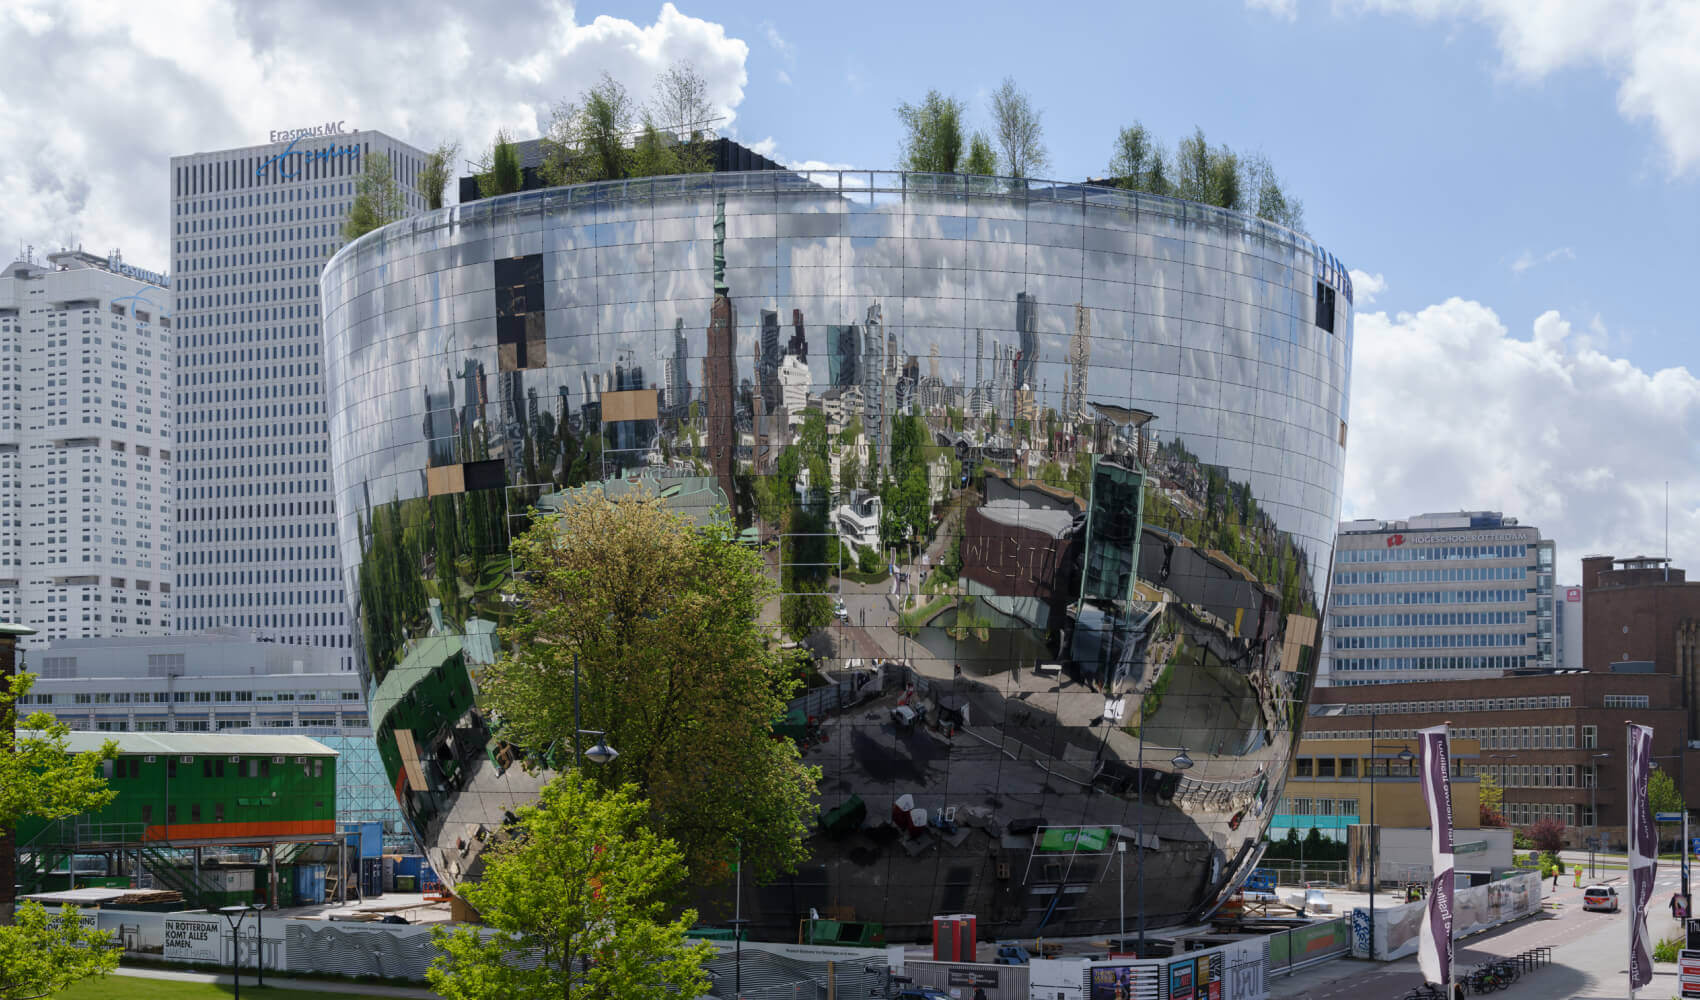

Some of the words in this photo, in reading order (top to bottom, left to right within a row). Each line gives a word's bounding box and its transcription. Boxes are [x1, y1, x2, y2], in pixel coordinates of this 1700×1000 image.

[269, 126, 323, 143] Erasmus
[324, 120, 345, 136] MC
[1411, 534, 1470, 545] HOGESCHOOL
[1471, 533, 1528, 543] ROTTERDAM
[165, 922, 174, 930] IN
[175, 922, 218, 933] ROTTERDAM
[165, 931, 187, 940] KOMT
[188, 932, 208, 942] ALLES
[165, 939, 193, 949] SAMEN.
